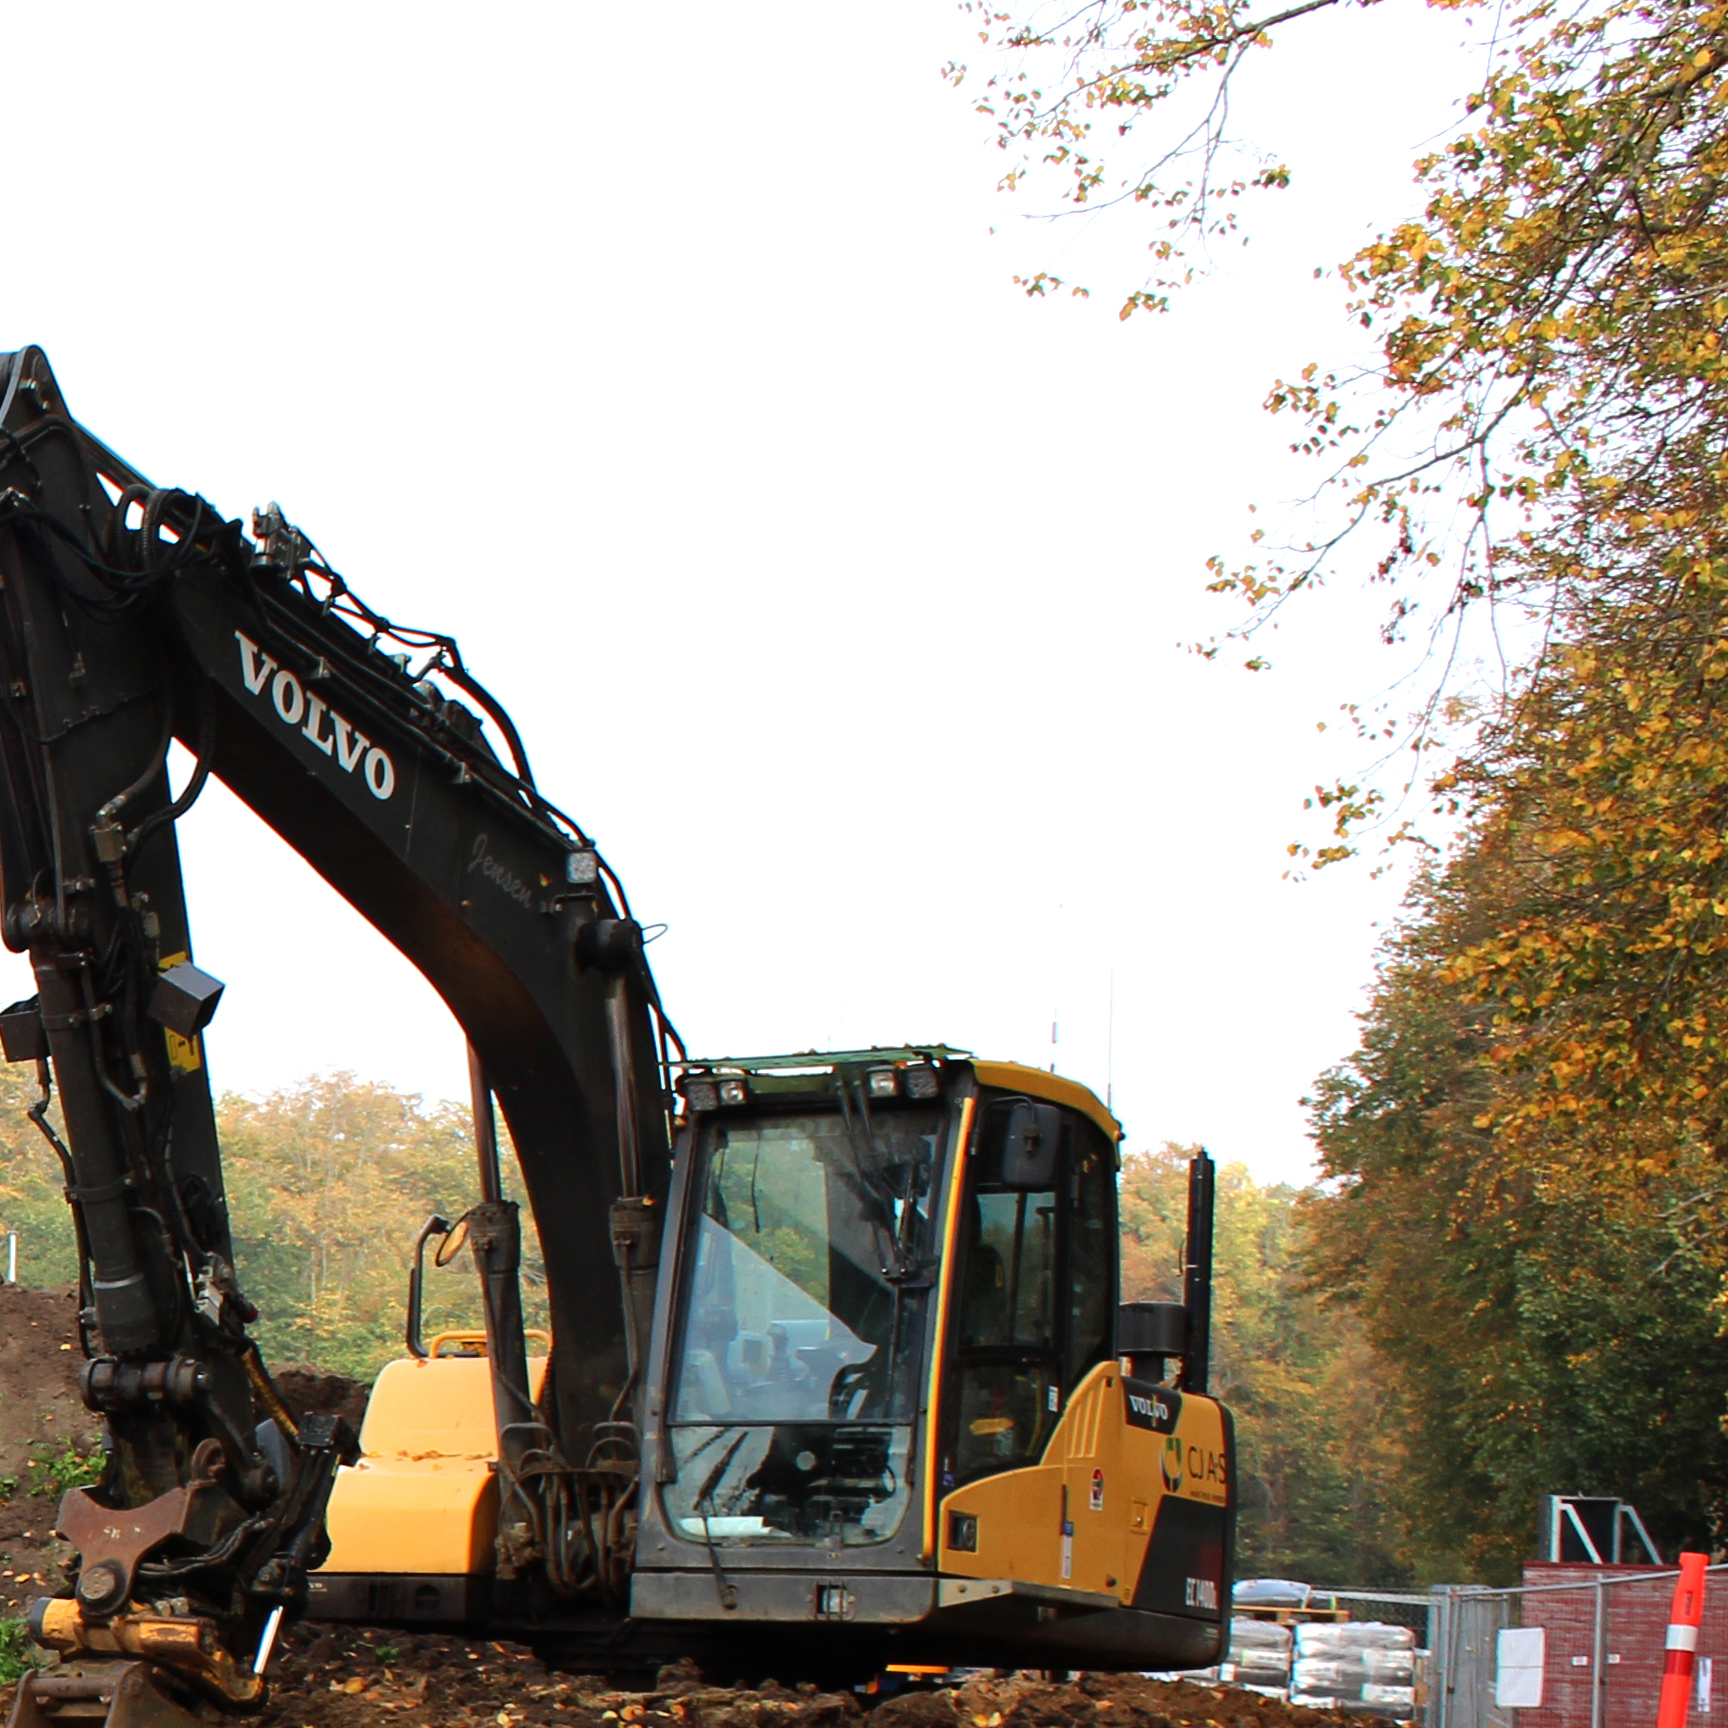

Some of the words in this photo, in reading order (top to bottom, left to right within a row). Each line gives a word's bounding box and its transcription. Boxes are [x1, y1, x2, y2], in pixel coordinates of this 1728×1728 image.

[235, 630, 395, 800] VOLVO
[467, 834, 532, 908] Jensen
[1129, 1394, 1169, 1420] VOLVO
